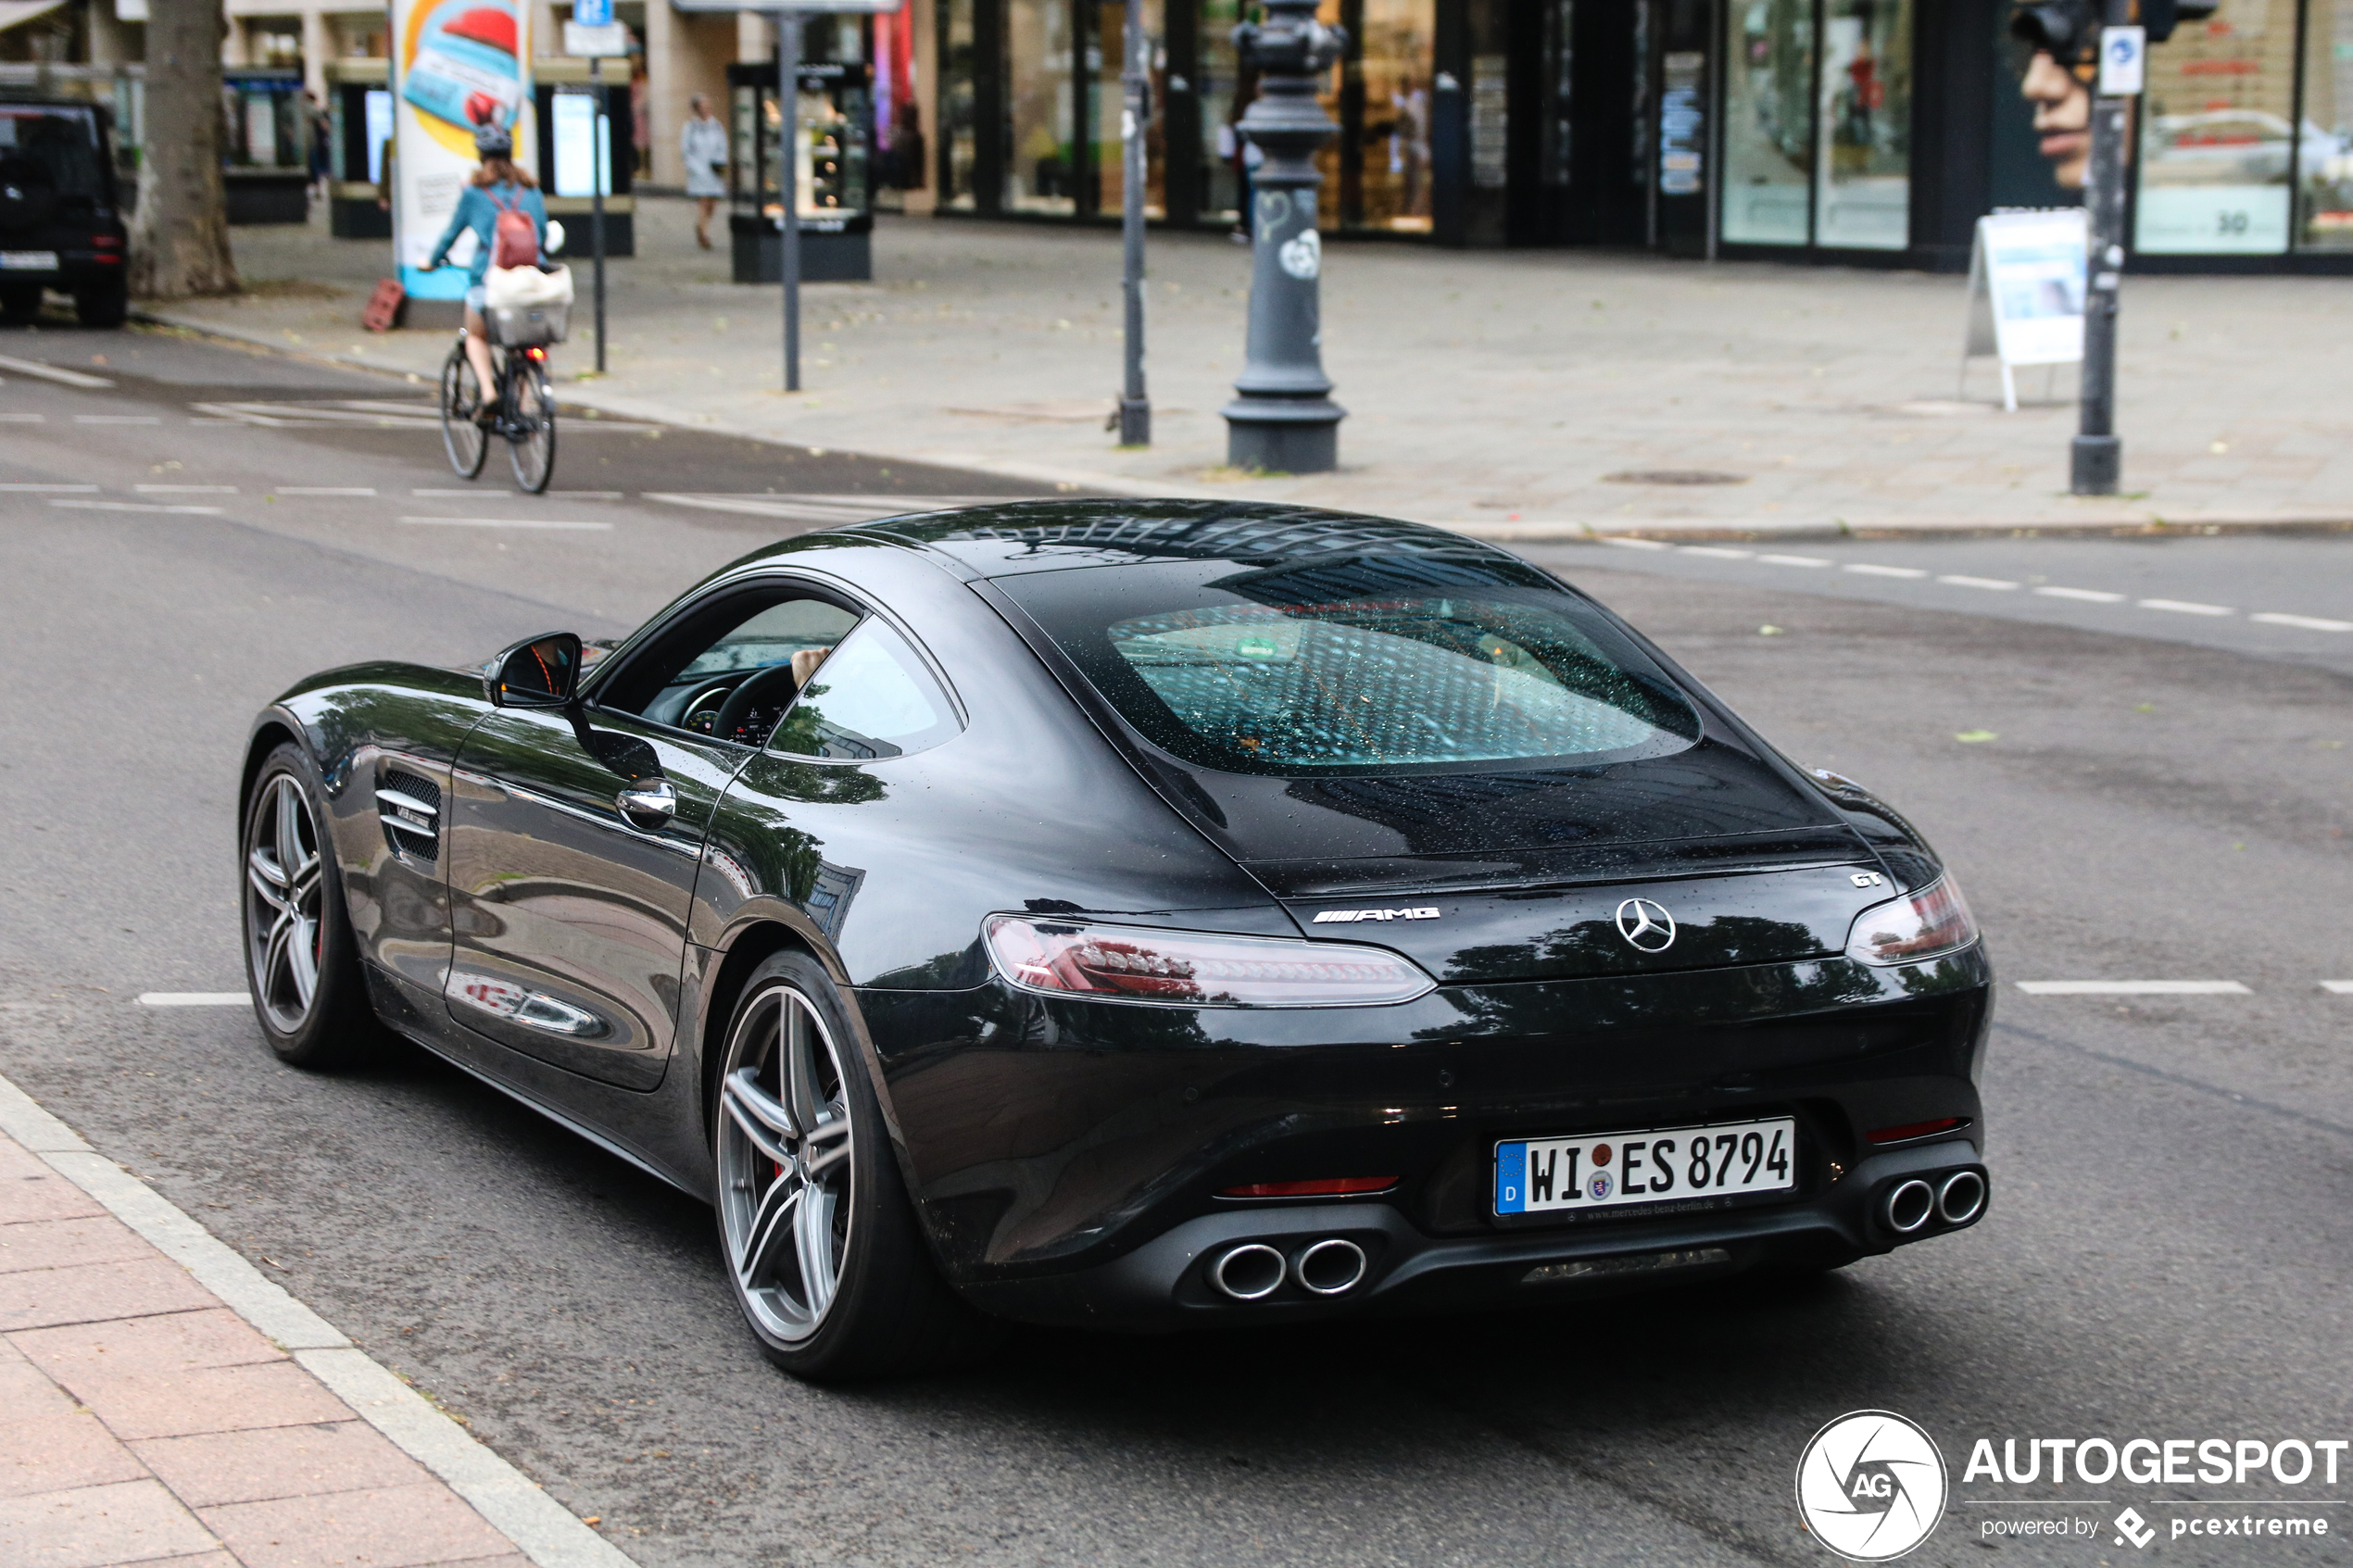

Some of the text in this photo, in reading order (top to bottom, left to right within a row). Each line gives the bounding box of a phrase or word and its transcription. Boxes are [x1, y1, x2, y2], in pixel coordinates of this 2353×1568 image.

[1849, 872, 1882, 888] GT
[1354, 907, 1441, 922] AMG
[1530, 1129, 1788, 1202] WI ES 8794
[1505, 1185, 1516, 1202] D
[1587, 1199, 1715, 1221] www.mercedes-benz-berlin.de
